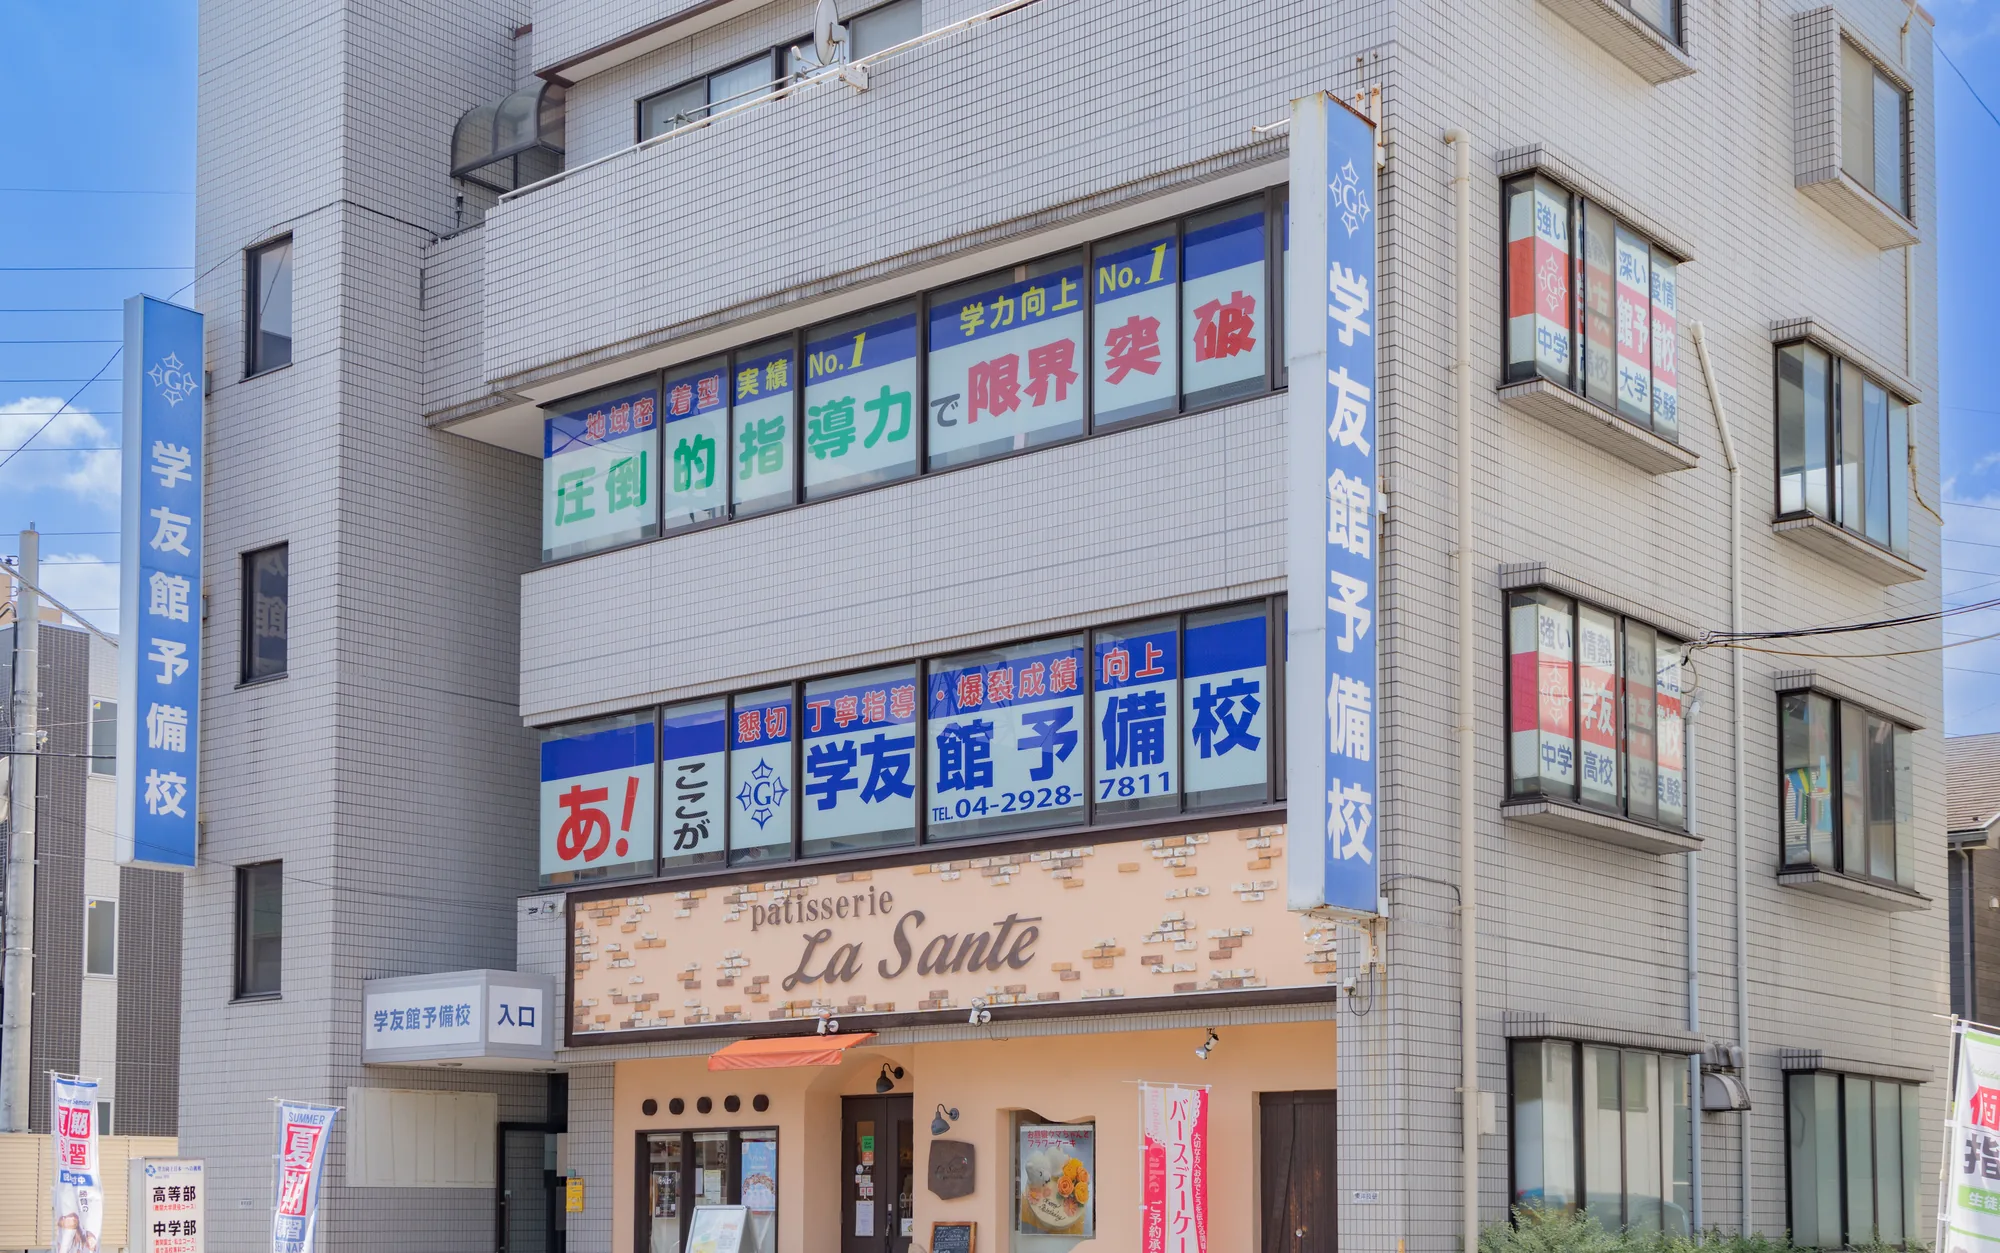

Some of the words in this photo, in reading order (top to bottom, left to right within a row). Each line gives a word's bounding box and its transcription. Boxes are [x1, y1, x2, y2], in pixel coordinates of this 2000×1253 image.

[1329, 261, 1372, 864] 学友館予備校
[144, 440, 192, 819] 学友館予備校
[805, 677, 1261, 811] 学友館予備校
[673, 762, 711, 850] ここが
[781, 928, 864, 992] La
[373, 1003, 471, 1033] 学友館予備校
[497, 1003, 535, 1028] 入口
[288, 1111, 326, 1125] SUMMER
[1027, 1139, 1077, 1148] フラワーケーキ
[152, 1185, 197, 1203] 高等部
[153, 1219, 197, 1237] 中学部
